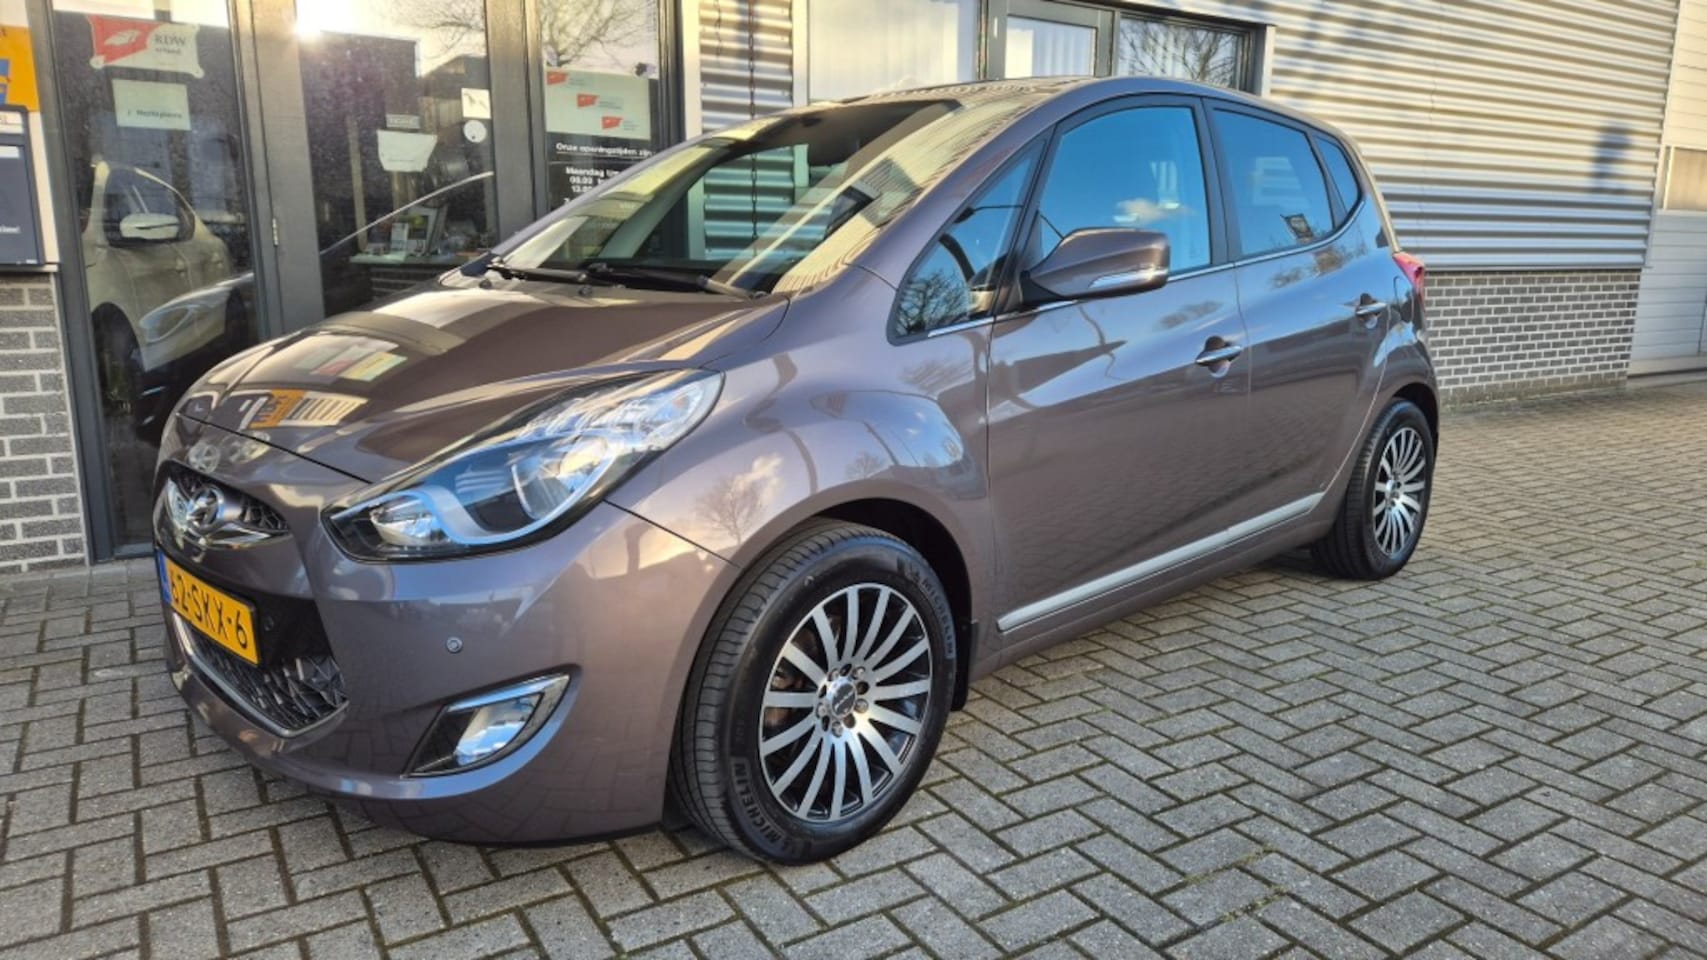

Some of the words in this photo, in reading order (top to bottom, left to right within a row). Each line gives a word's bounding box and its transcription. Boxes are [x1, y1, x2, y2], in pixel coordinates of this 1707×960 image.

[556, 142, 578, 151] Onze
[566, 167, 605, 178] Maandag
[733, 762, 783, 844] MICHELIN
